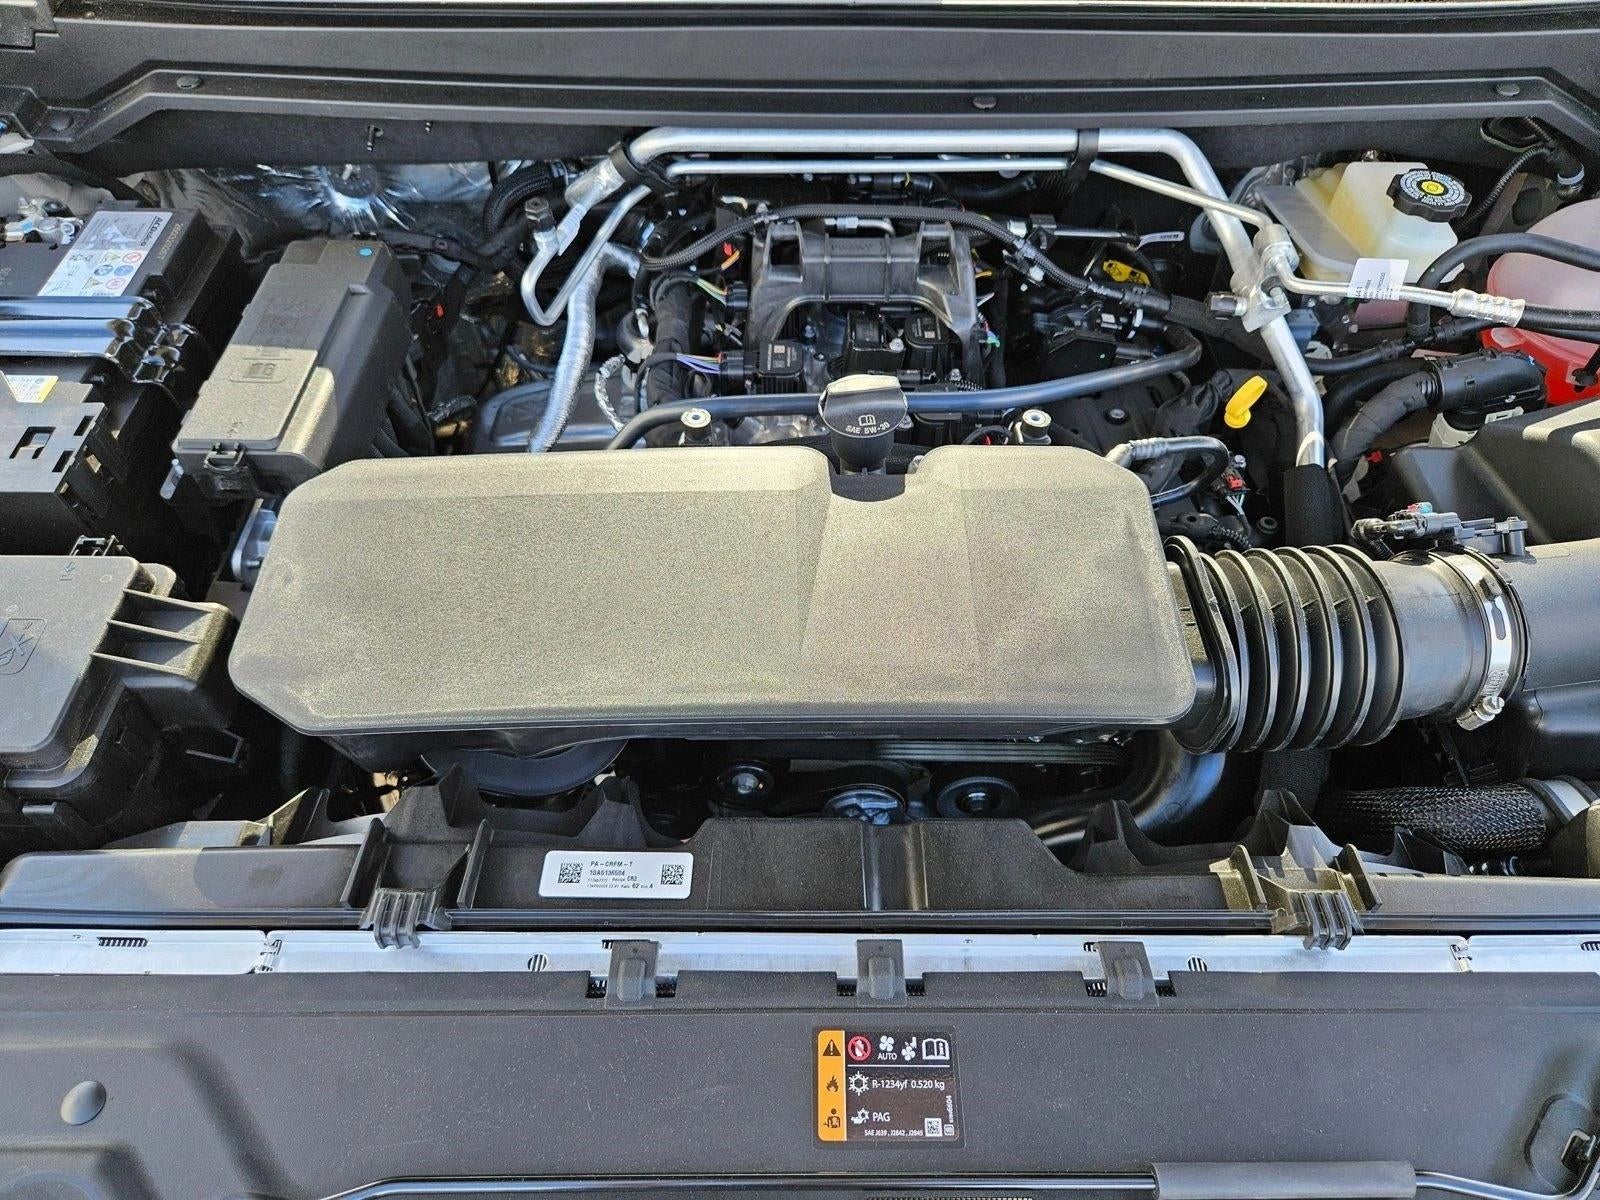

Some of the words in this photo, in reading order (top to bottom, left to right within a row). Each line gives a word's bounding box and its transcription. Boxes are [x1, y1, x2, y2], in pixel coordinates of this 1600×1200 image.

[845, 424, 861, 434] SAE
[864, 421, 891, 434] 5W-30
[877, 1052, 898, 1060] AUTO
[872, 1079, 908, 1091] R-1234yf
[910, 1080, 934, 1089] 0.520
[934, 1079, 946, 1091] kg
[872, 1111, 891, 1122] PAG
[864, 1129, 875, 1137] SAE
